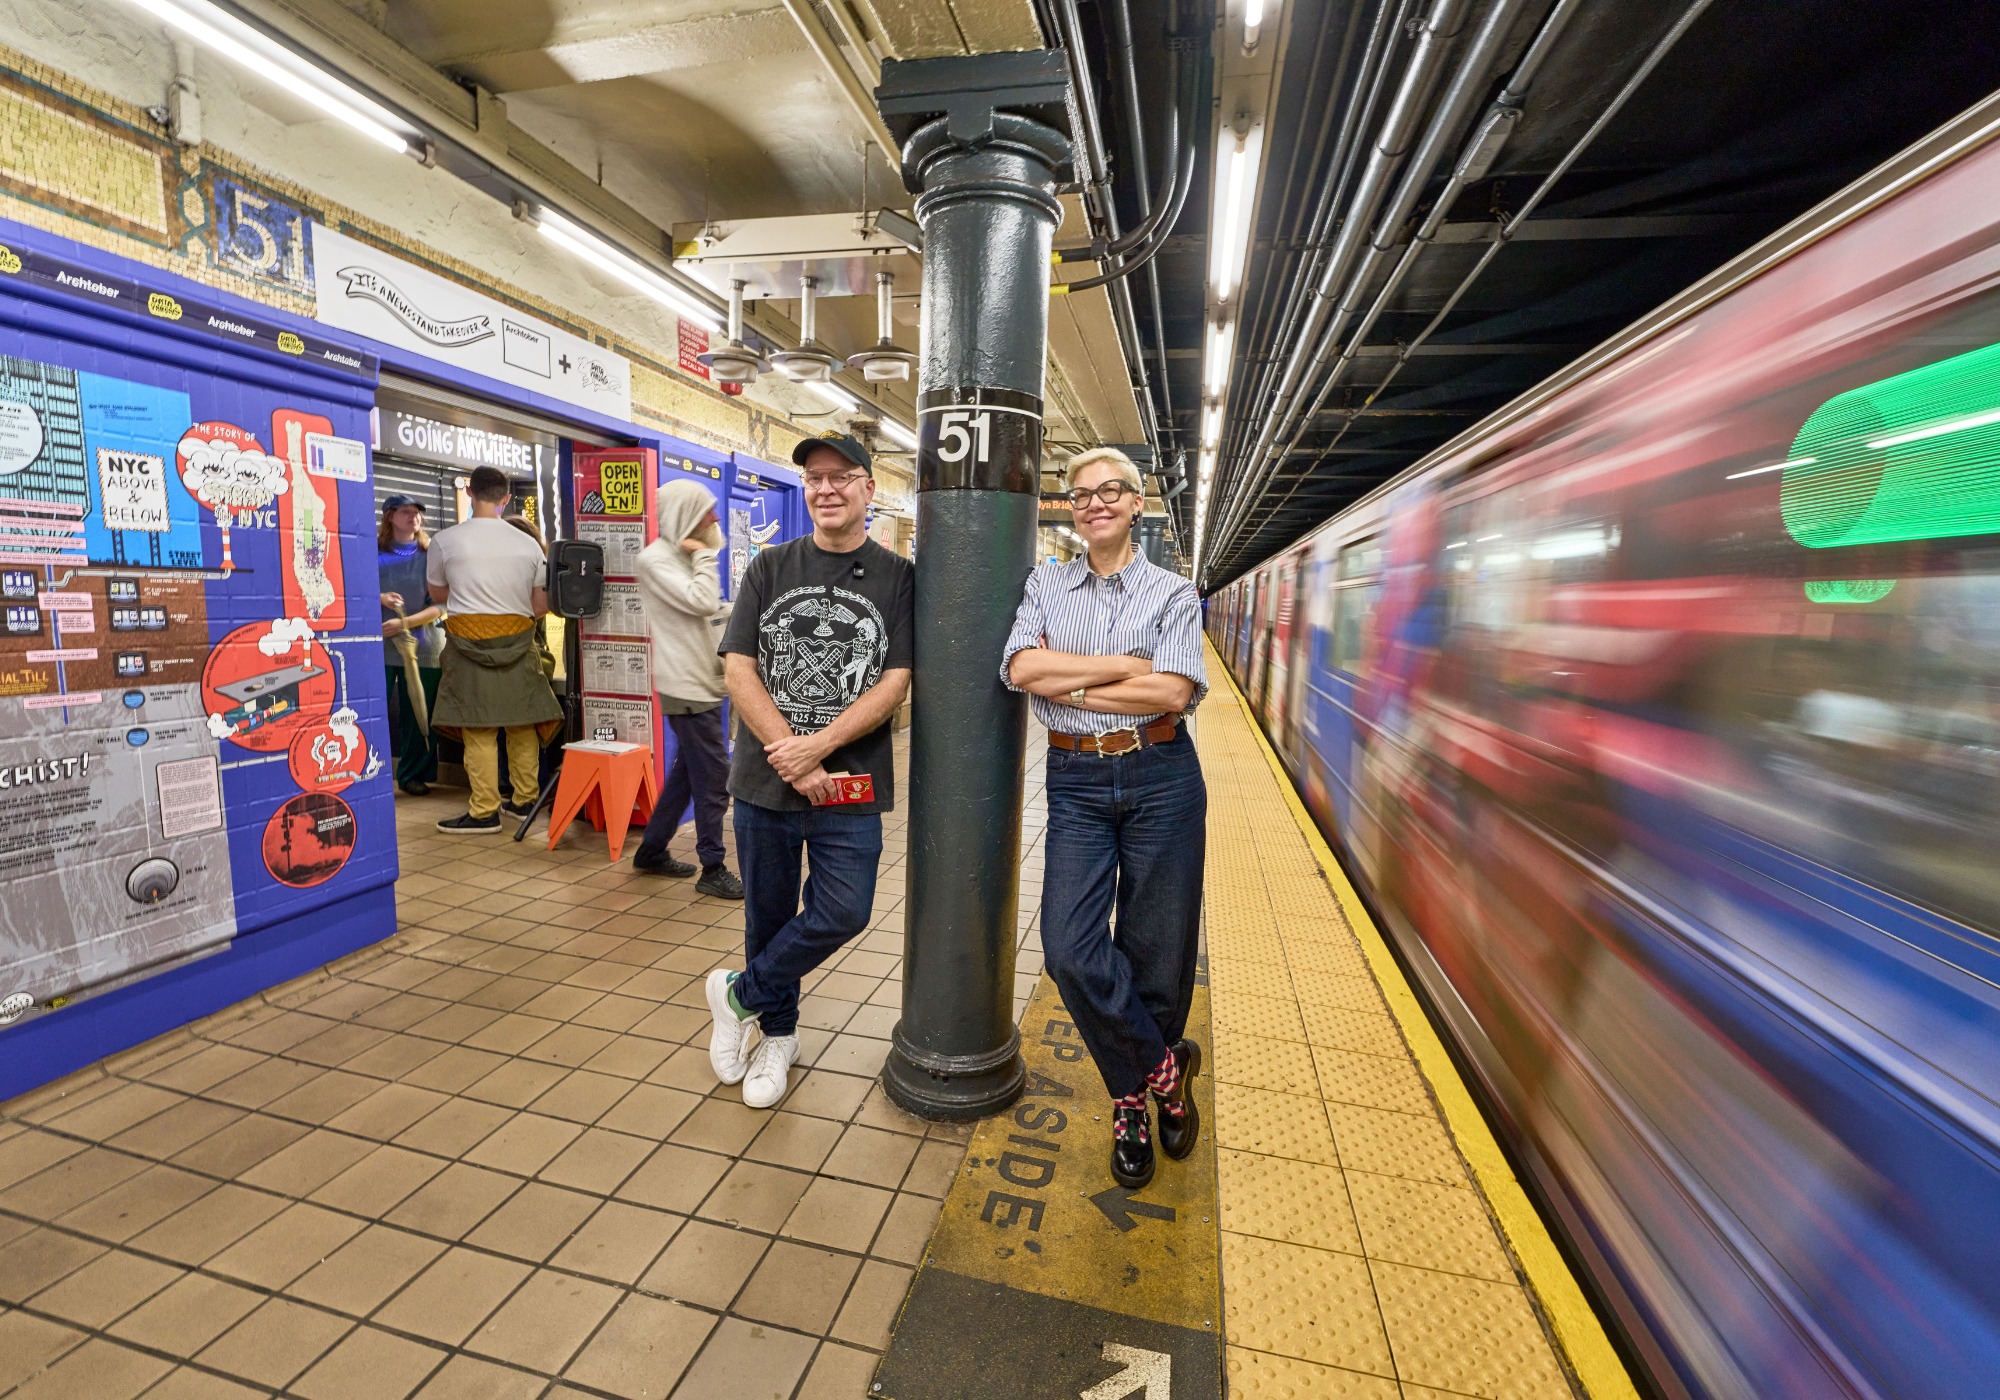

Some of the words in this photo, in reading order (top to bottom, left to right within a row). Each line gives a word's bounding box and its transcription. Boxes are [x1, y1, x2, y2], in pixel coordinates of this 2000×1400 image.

[229, 188, 305, 284] 51
[56, 270, 120, 299] Archtober
[354, 272, 377, 291] IT'S
[379, 286, 386, 296] A
[386, 290, 440, 336] NEWSSTAND
[440, 322, 480, 338] TAKEOVER
[207, 315, 256, 338] Archtober
[506, 324, 539, 344] Archtober
[323, 350, 361, 368] Archtober
[192, 422, 211, 434] THE
[213, 426, 242, 441] STORY
[244, 432, 256, 442] OF
[937, 412, 990, 462] 51
[456, 433, 534, 472] ANYWHERE
[108, 456, 150, 475] NYC
[604, 465, 638, 480] OPEN
[107, 476, 159, 492] ABOVE
[606, 481, 639, 494] COME
[203, 481, 274, 509] STEAM
[1053, 501, 1073, 510] Bridg
[109, 506, 162, 524] BELOW
[239, 508, 277, 529] NYC
[609, 524, 642, 533] NEWSPAPER
[169, 550, 201, 559] STREET
[171, 559, 199, 567] LEVEL
[583, 643, 613, 651] NEWSPAPE
[614, 644, 646, 653] NEWSPAPER
[776, 641, 789, 651] NY
[585, 700, 616, 709] NEWSPAPE
[616, 702, 649, 711] NEWSPAPER
[791, 712, 809, 723] 1625
[980, 1070, 1075, 1233] ASIDE
